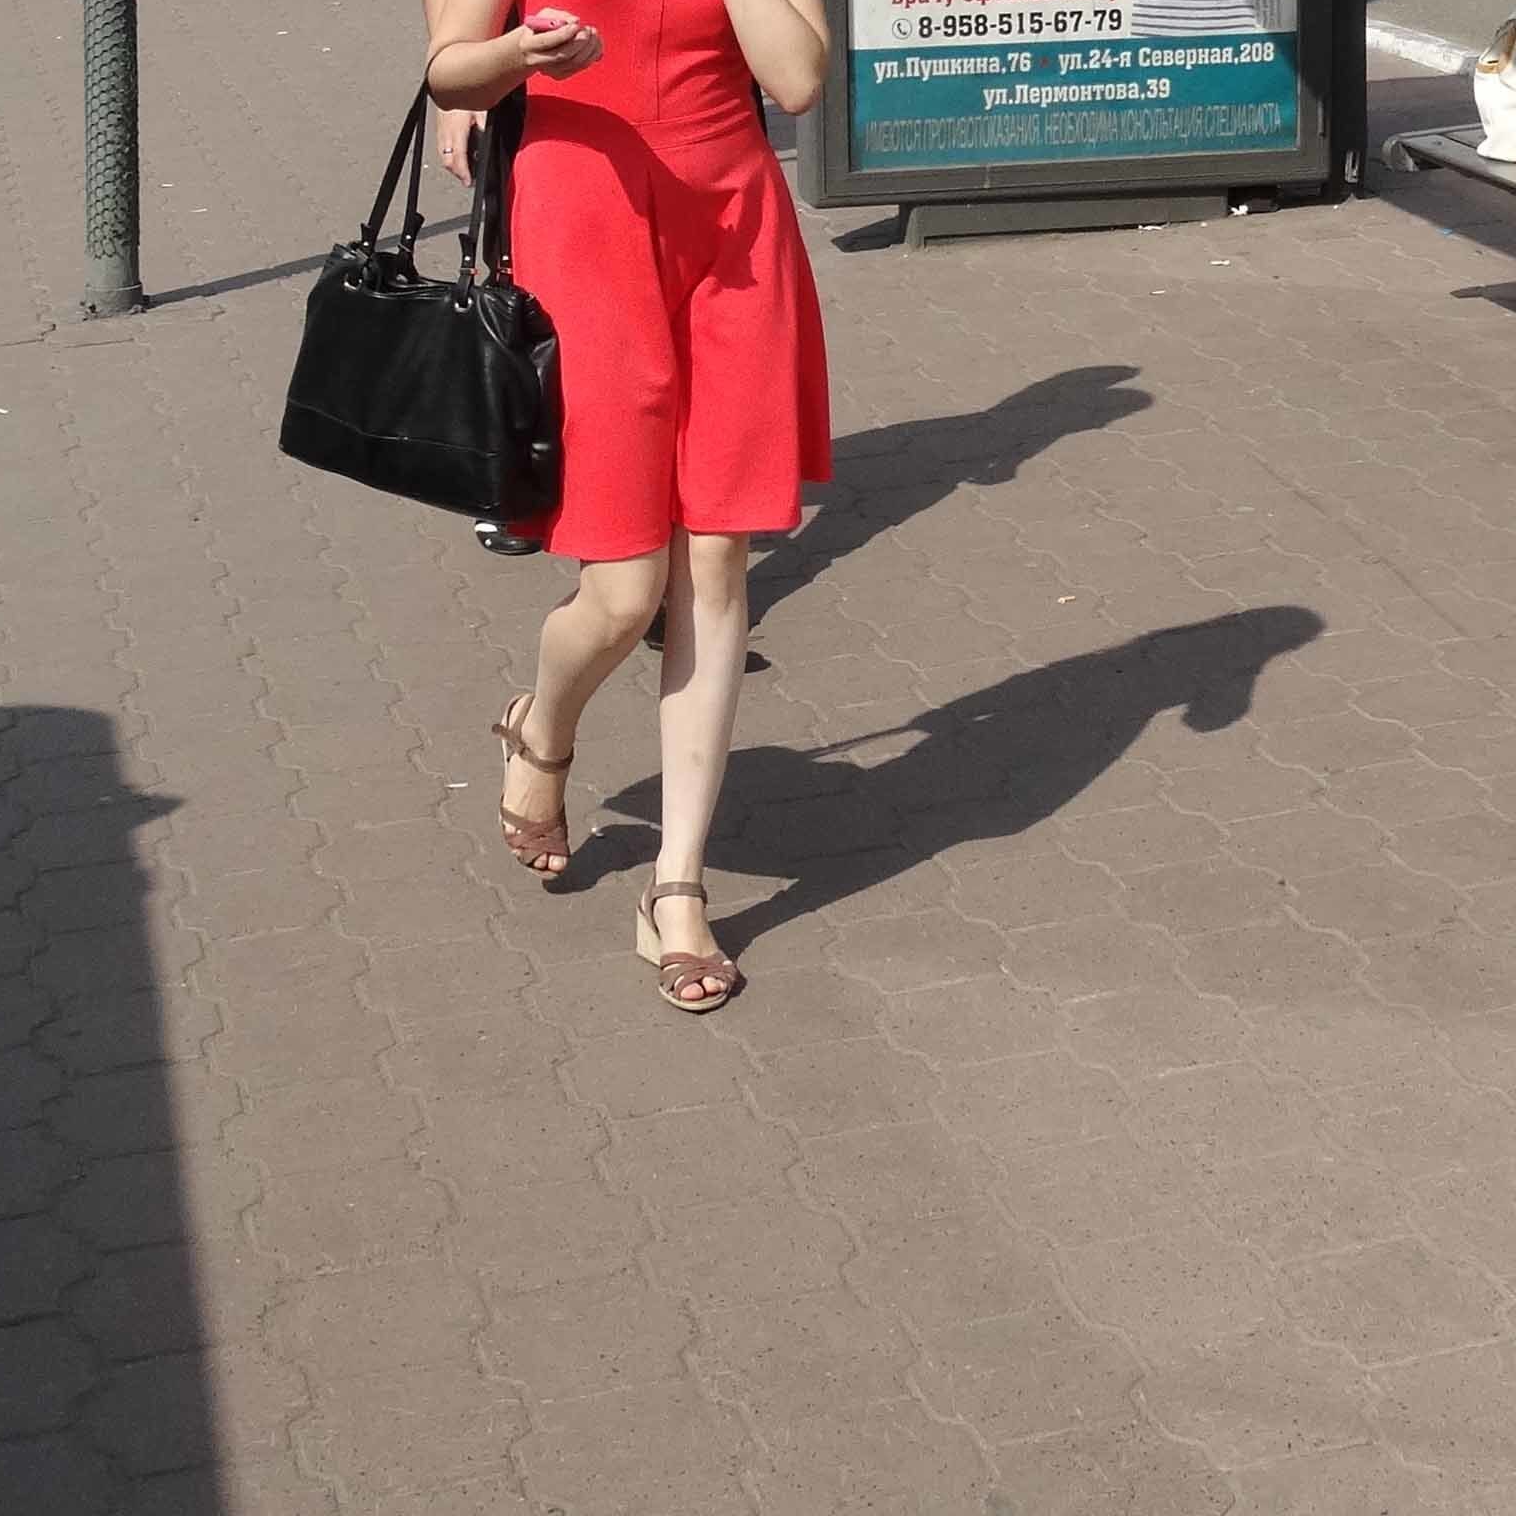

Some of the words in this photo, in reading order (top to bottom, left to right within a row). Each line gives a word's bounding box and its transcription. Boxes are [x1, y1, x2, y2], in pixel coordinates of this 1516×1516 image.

[918, 8, 1123, 39] 8-958-515-67-79
[874, 51, 1032, 83] ул.Пушкина,76
[1058, 48, 1131, 72] ул.24-я
[1138, 41, 1275, 69] Северная,208
[984, 78, 1171, 111] ул.Лермонтова,39
